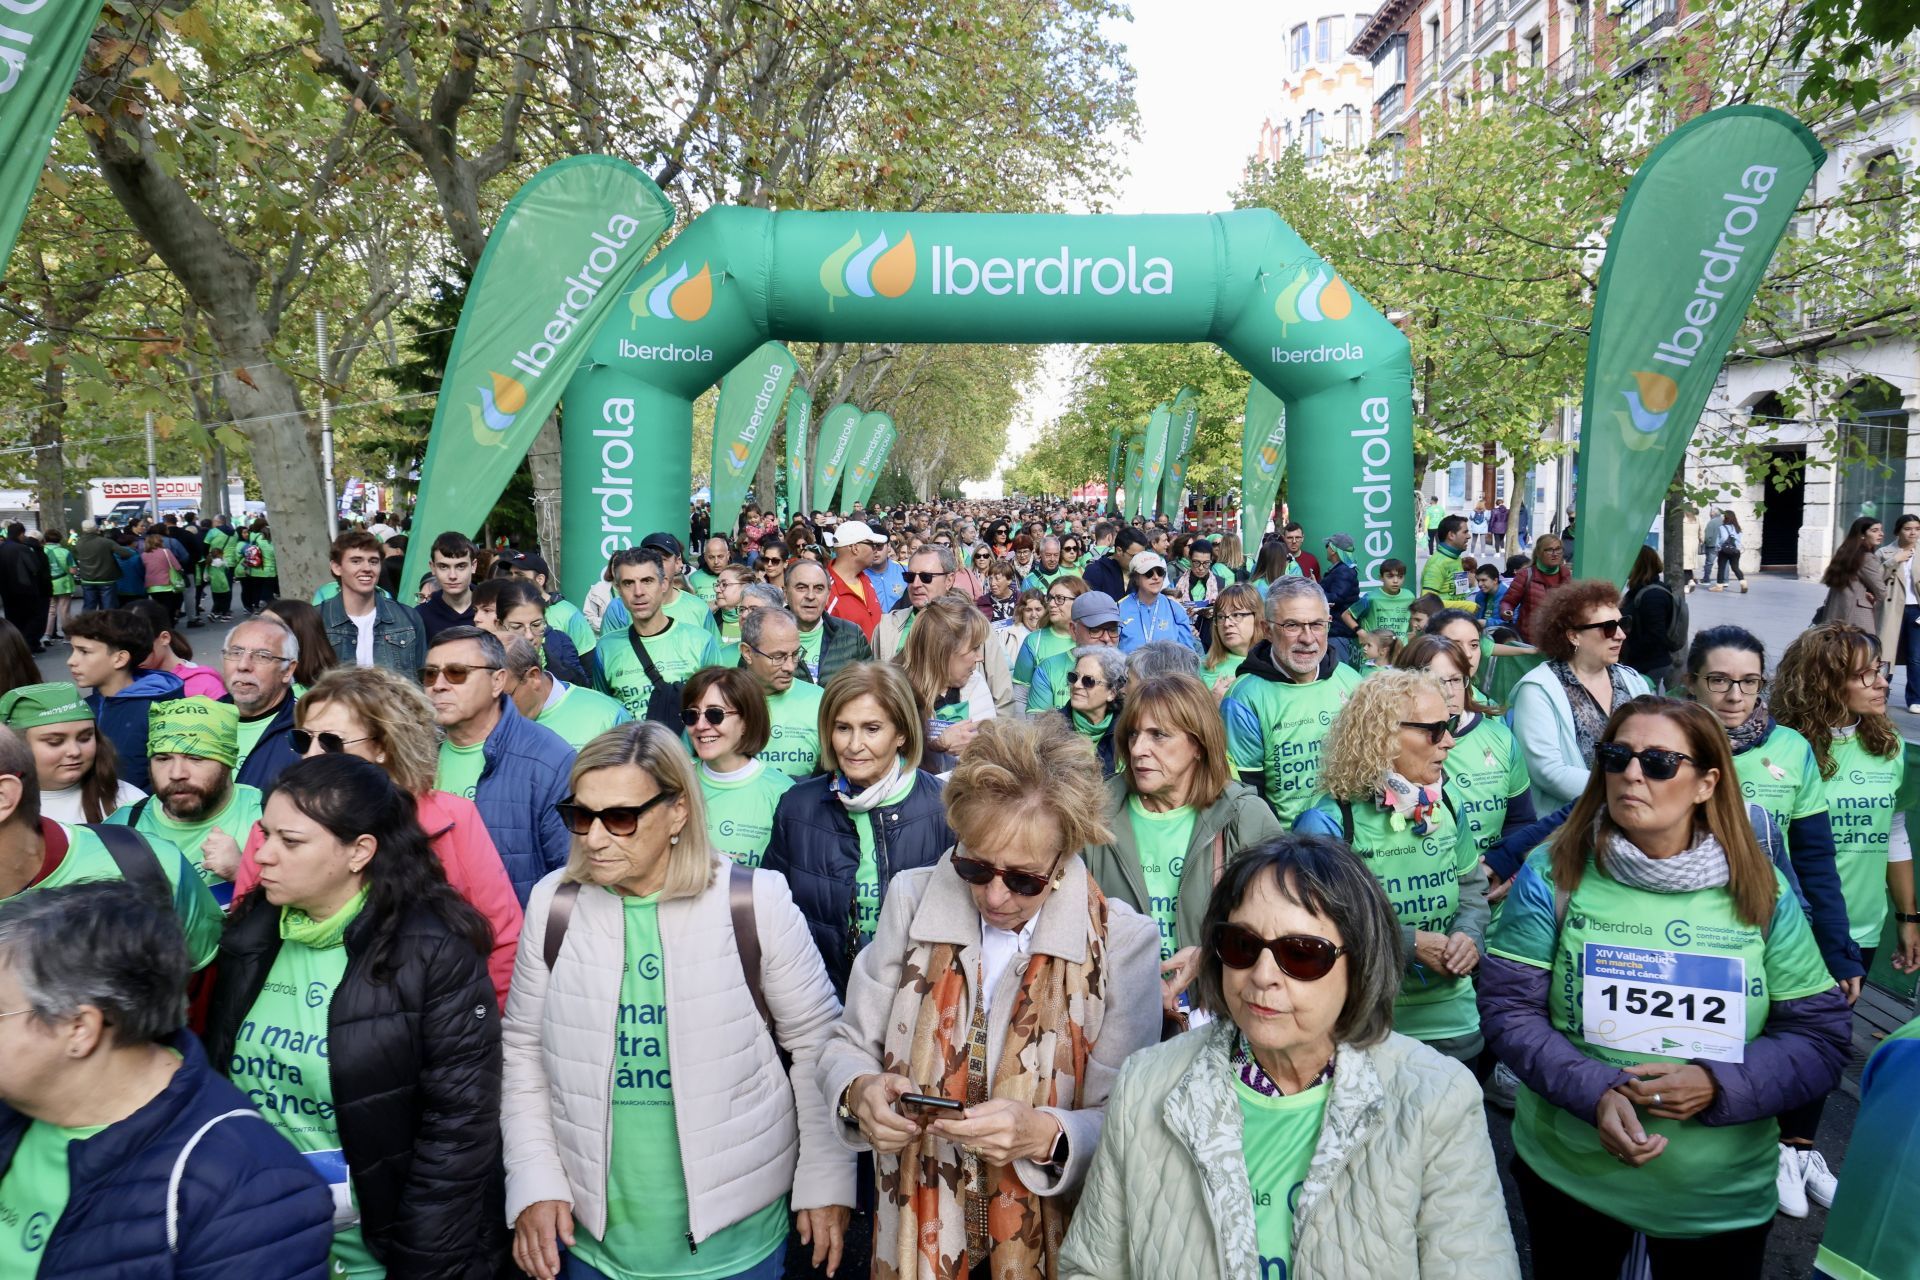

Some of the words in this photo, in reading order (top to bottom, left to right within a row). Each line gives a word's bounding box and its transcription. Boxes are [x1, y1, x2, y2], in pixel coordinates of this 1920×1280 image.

[932, 245, 1174, 296] Iberdrola
[1653, 164, 1778, 367] Iberdrola
[511, 213, 640, 378] Iberdrola
[619, 338, 714, 362] Iberdrola
[1271, 342, 1364, 363] Iberdrola
[739, 364, 783, 443] Iberdrola
[103, 483, 149, 494] GLOBA
[592, 397, 635, 580] erdrola
[1351, 397, 1393, 597] berdrola
[1282, 741, 1304, 757] En
[1283, 775, 1301, 791] el
[1831, 811, 1873, 827] ntra
[1832, 829, 1889, 844] cánce
[1376, 845, 1417, 858] Iberdrola
[1391, 894, 1448, 916] ontra
[1589, 918, 1653, 936] Iberdrola
[1595, 948, 1614, 959] XIV
[1616, 951, 1670, 965] Valladolid
[1595, 958, 1608, 966] en
[1609, 959, 1643, 969] marcha
[1595, 966, 1625, 976] contra
[1627, 969, 1636, 977] el
[1637, 970, 1669, 980] cáncer
[1601, 984, 1727, 1025] 15212
[229, 1053, 303, 1087] ontra
[247, 1085, 335, 1120] cánce
